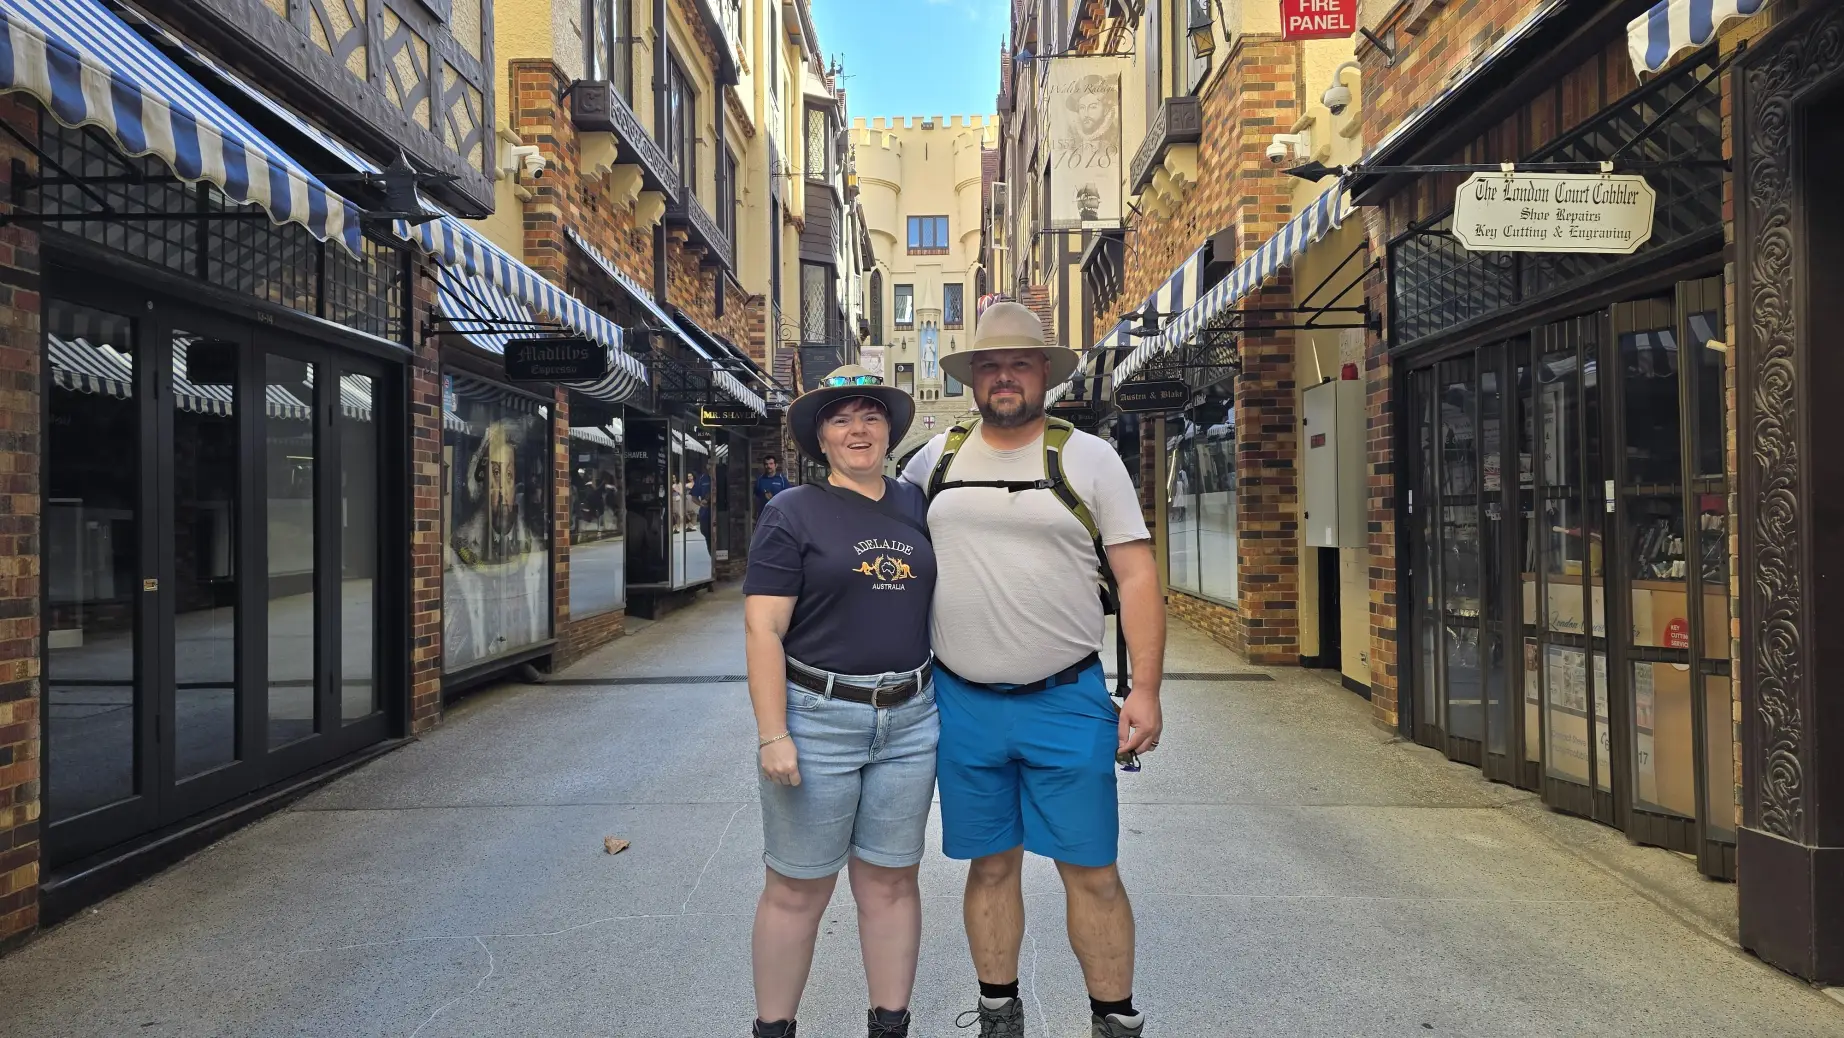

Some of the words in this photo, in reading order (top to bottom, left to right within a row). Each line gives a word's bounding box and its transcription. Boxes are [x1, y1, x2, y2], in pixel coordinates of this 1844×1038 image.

[1299, 0, 1341, 12] FIRE
[1290, 14, 1351, 31] PANEL
[1053, 144, 1118, 170] 1618
[1474, 178, 1498, 204] The
[1503, 179, 1550, 203] London
[1555, 181, 1590, 204] Court
[1592, 182, 1640, 205] Cobbler
[1519, 207, 1550, 221] Shoe
[1556, 208, 1601, 224] Repairs
[1474, 224, 1498, 240] Key
[1503, 224, 1547, 241] Cutting
[1552, 225, 1563, 238] &
[1569, 225, 1631, 242] Engraving
[517, 345, 589, 363] Madlilys
[530, 364, 577, 376] Espresso
[1119, 393, 1147, 401] Austen
[1149, 391, 1157, 400] &
[1160, 391, 1183, 399] Blake
[703, 410, 721, 419] MR.
[722, 411, 757, 419] SHAVER
[853, 539, 914, 556] ADELAIDE
[872, 583, 906, 591] AUSTRALIA
[1670, 632, 1689, 641] CUTTIN
[1671, 640, 1689, 648] SERVIC
